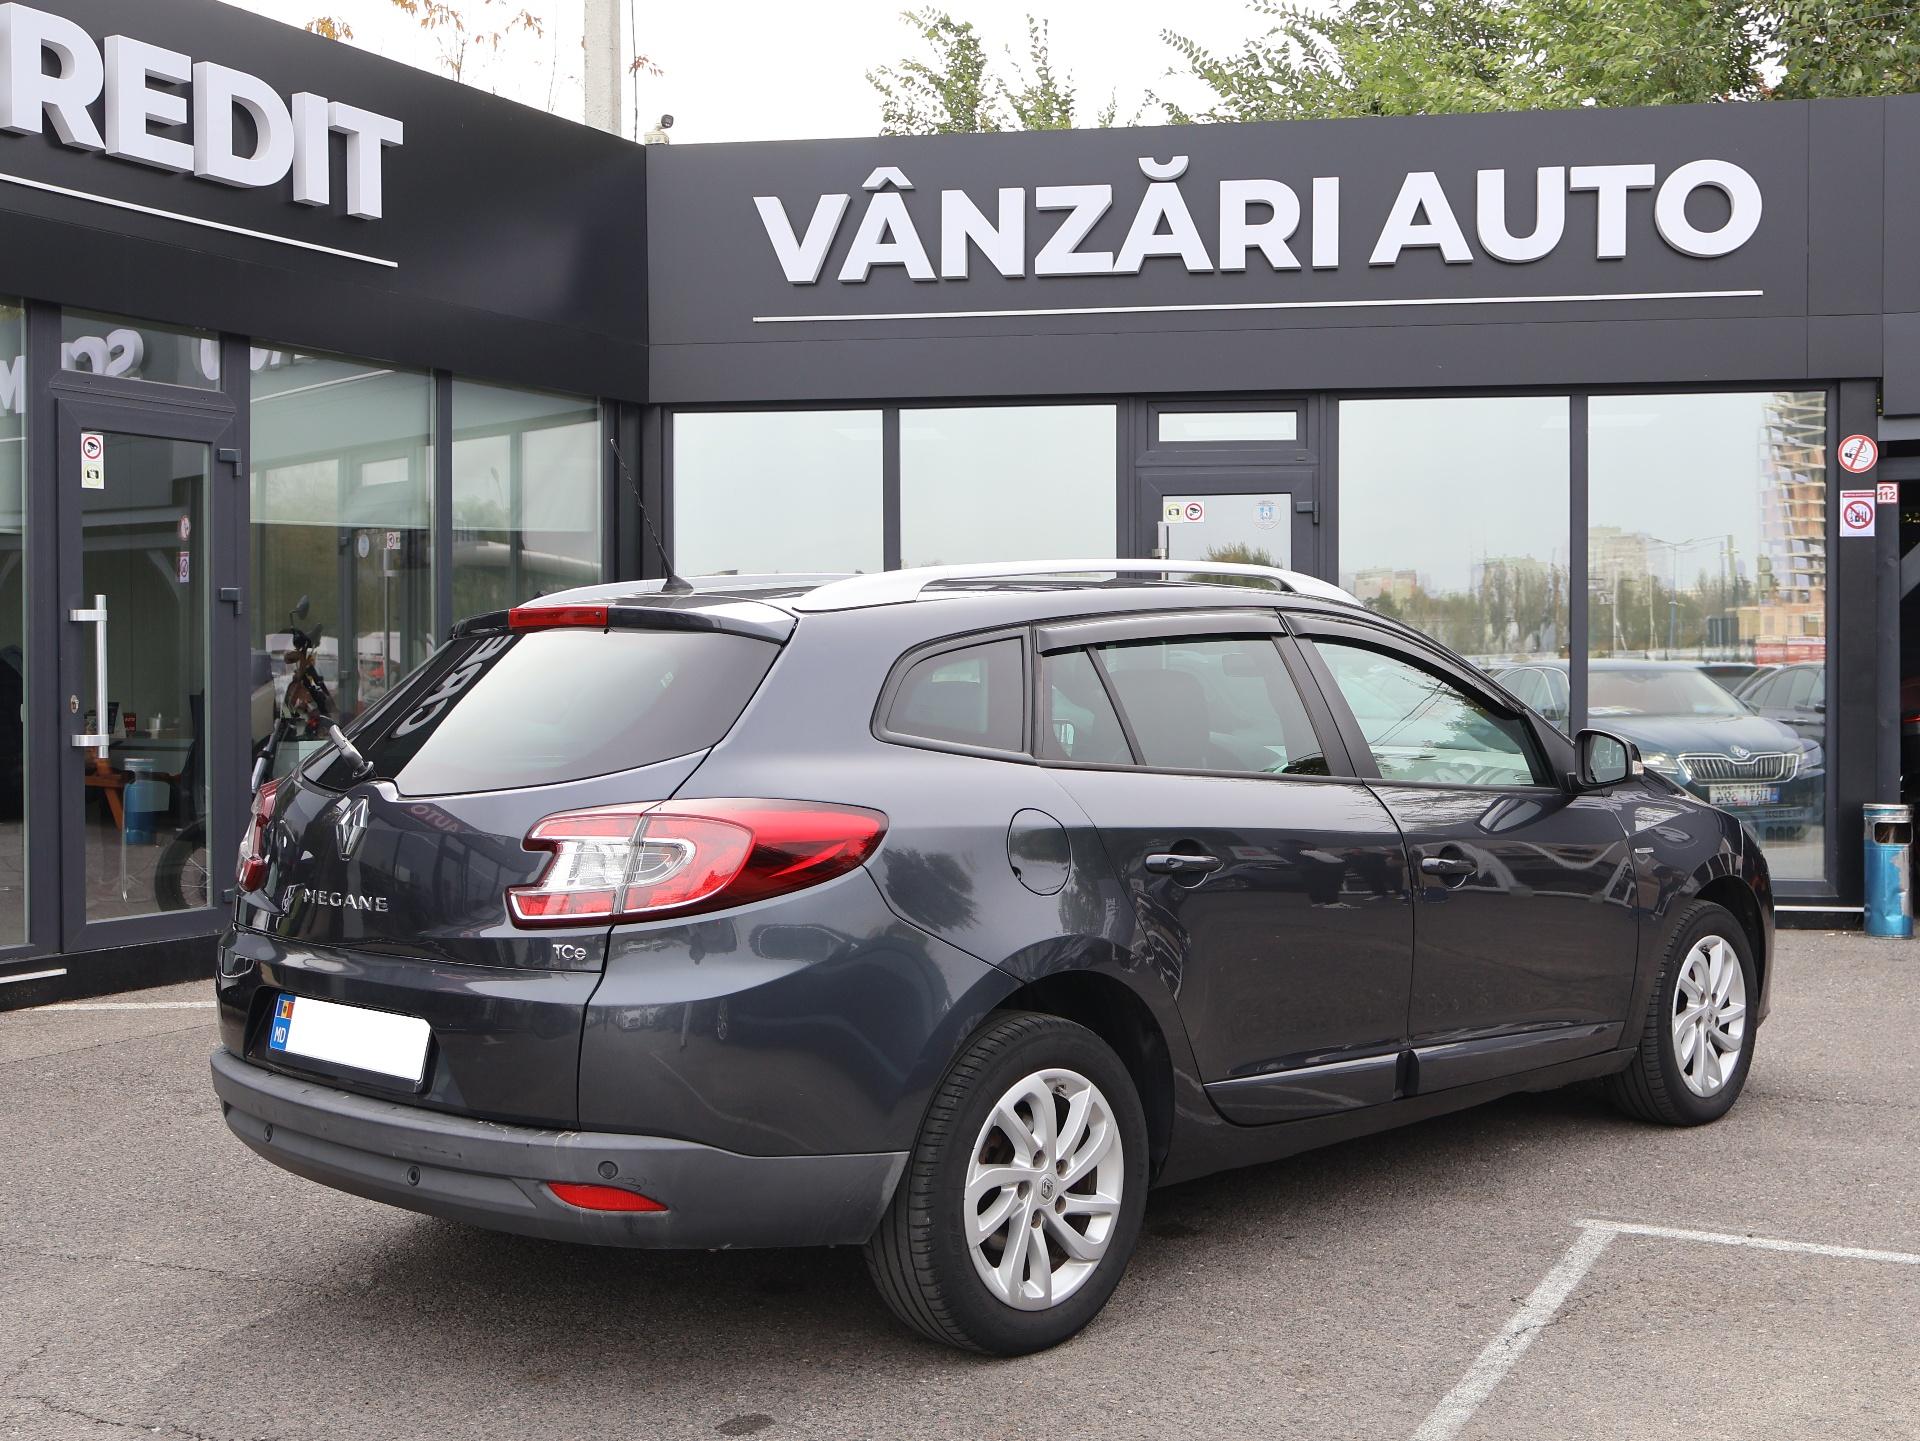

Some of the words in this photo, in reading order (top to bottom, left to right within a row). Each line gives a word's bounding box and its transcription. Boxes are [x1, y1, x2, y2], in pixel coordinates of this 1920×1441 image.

[0, 2, 403, 220] REDIT
[753, 155, 1340, 285] VÂNZĂRI
[1369, 160, 1763, 265] AUTO
[1878, 492, 1896, 500] 112
[303, 888, 388, 912] MEGANE
[552, 944, 587, 960] TCe
[273, 1026, 287, 1043] MD
